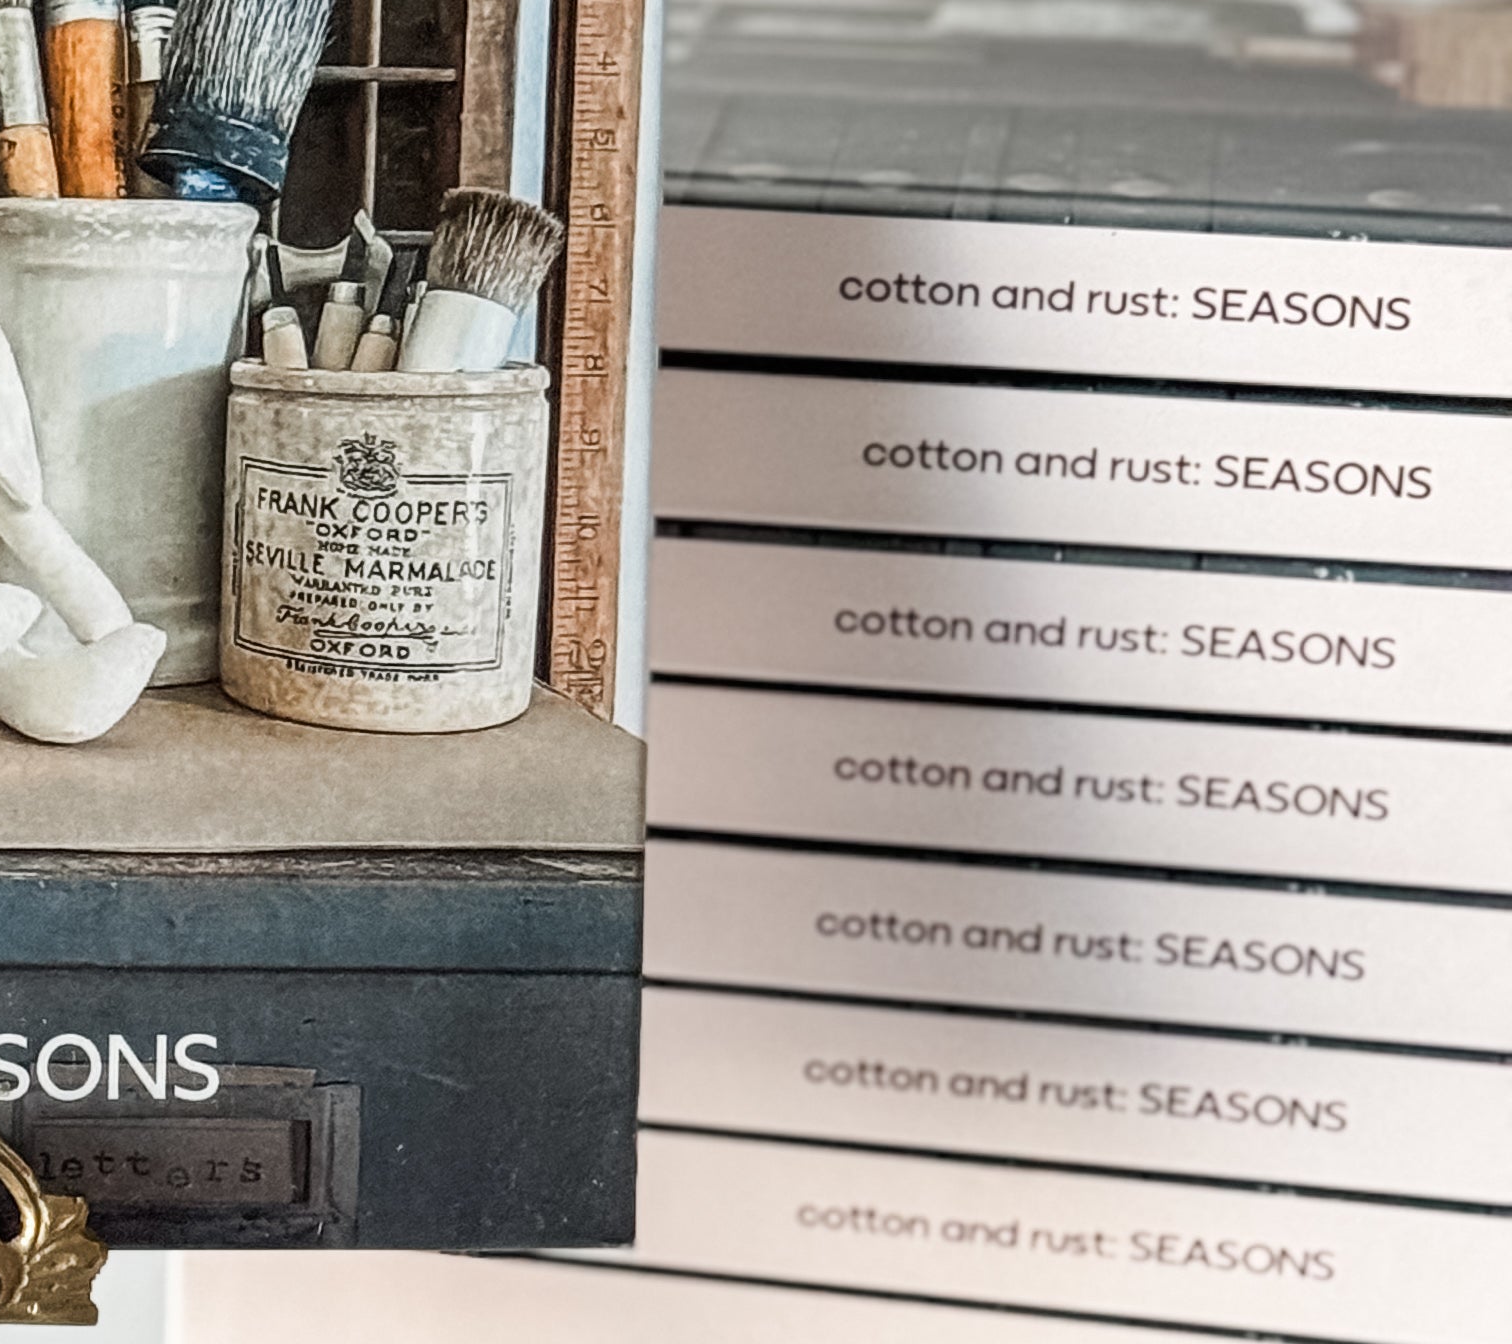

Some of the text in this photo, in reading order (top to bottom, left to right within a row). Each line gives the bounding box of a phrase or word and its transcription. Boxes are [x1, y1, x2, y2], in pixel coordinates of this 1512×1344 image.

[595, 50, 619, 72] 4
[591, 128, 616, 150] 5
[587, 276, 609, 299] 7
[837, 271, 1413, 333] cotton and rust: SEASONS
[579, 428, 602, 448] 9
[860, 437, 1434, 502] cotton and rust: SEASONS
[256, 486, 489, 526] FRANK COOPER'S
[245, 539, 497, 583] SEVILLE MARMALADE
[309, 638, 411, 660] OXFORD
[832, 606, 1398, 672] cotton and rust: SEASONS
[831, 754, 1391, 824] cotton and rust: SEASONS
[813, 910, 1367, 984] cotton and rust: SEASONS
[801, 1057, 1350, 1135] cotton and rust: SEASONS
[37, 1153, 265, 1190] letters
[794, 1202, 1337, 1283] cotton and rust: SEASONS
